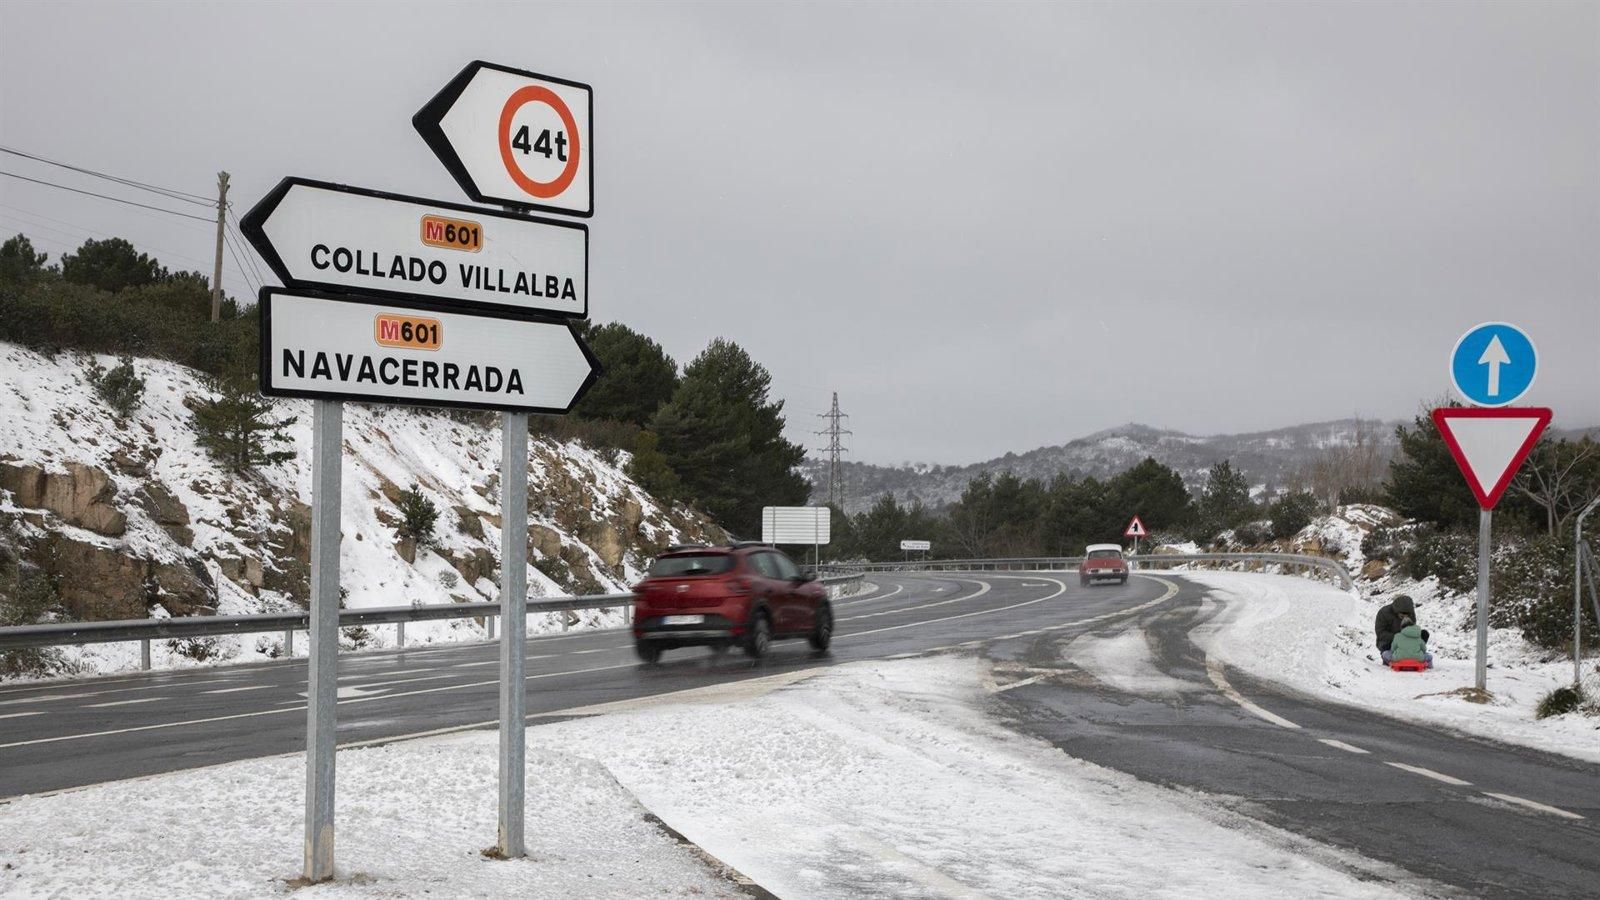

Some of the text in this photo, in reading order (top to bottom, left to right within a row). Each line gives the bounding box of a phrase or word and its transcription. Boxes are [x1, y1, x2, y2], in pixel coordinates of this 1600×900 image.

[512, 125, 568, 162] 44t
[425, 220, 479, 247] M601
[310, 244, 577, 301] COLLADO VILLALBA
[380, 319, 438, 345] M601
[282, 348, 524, 395] NAVACERRADA
